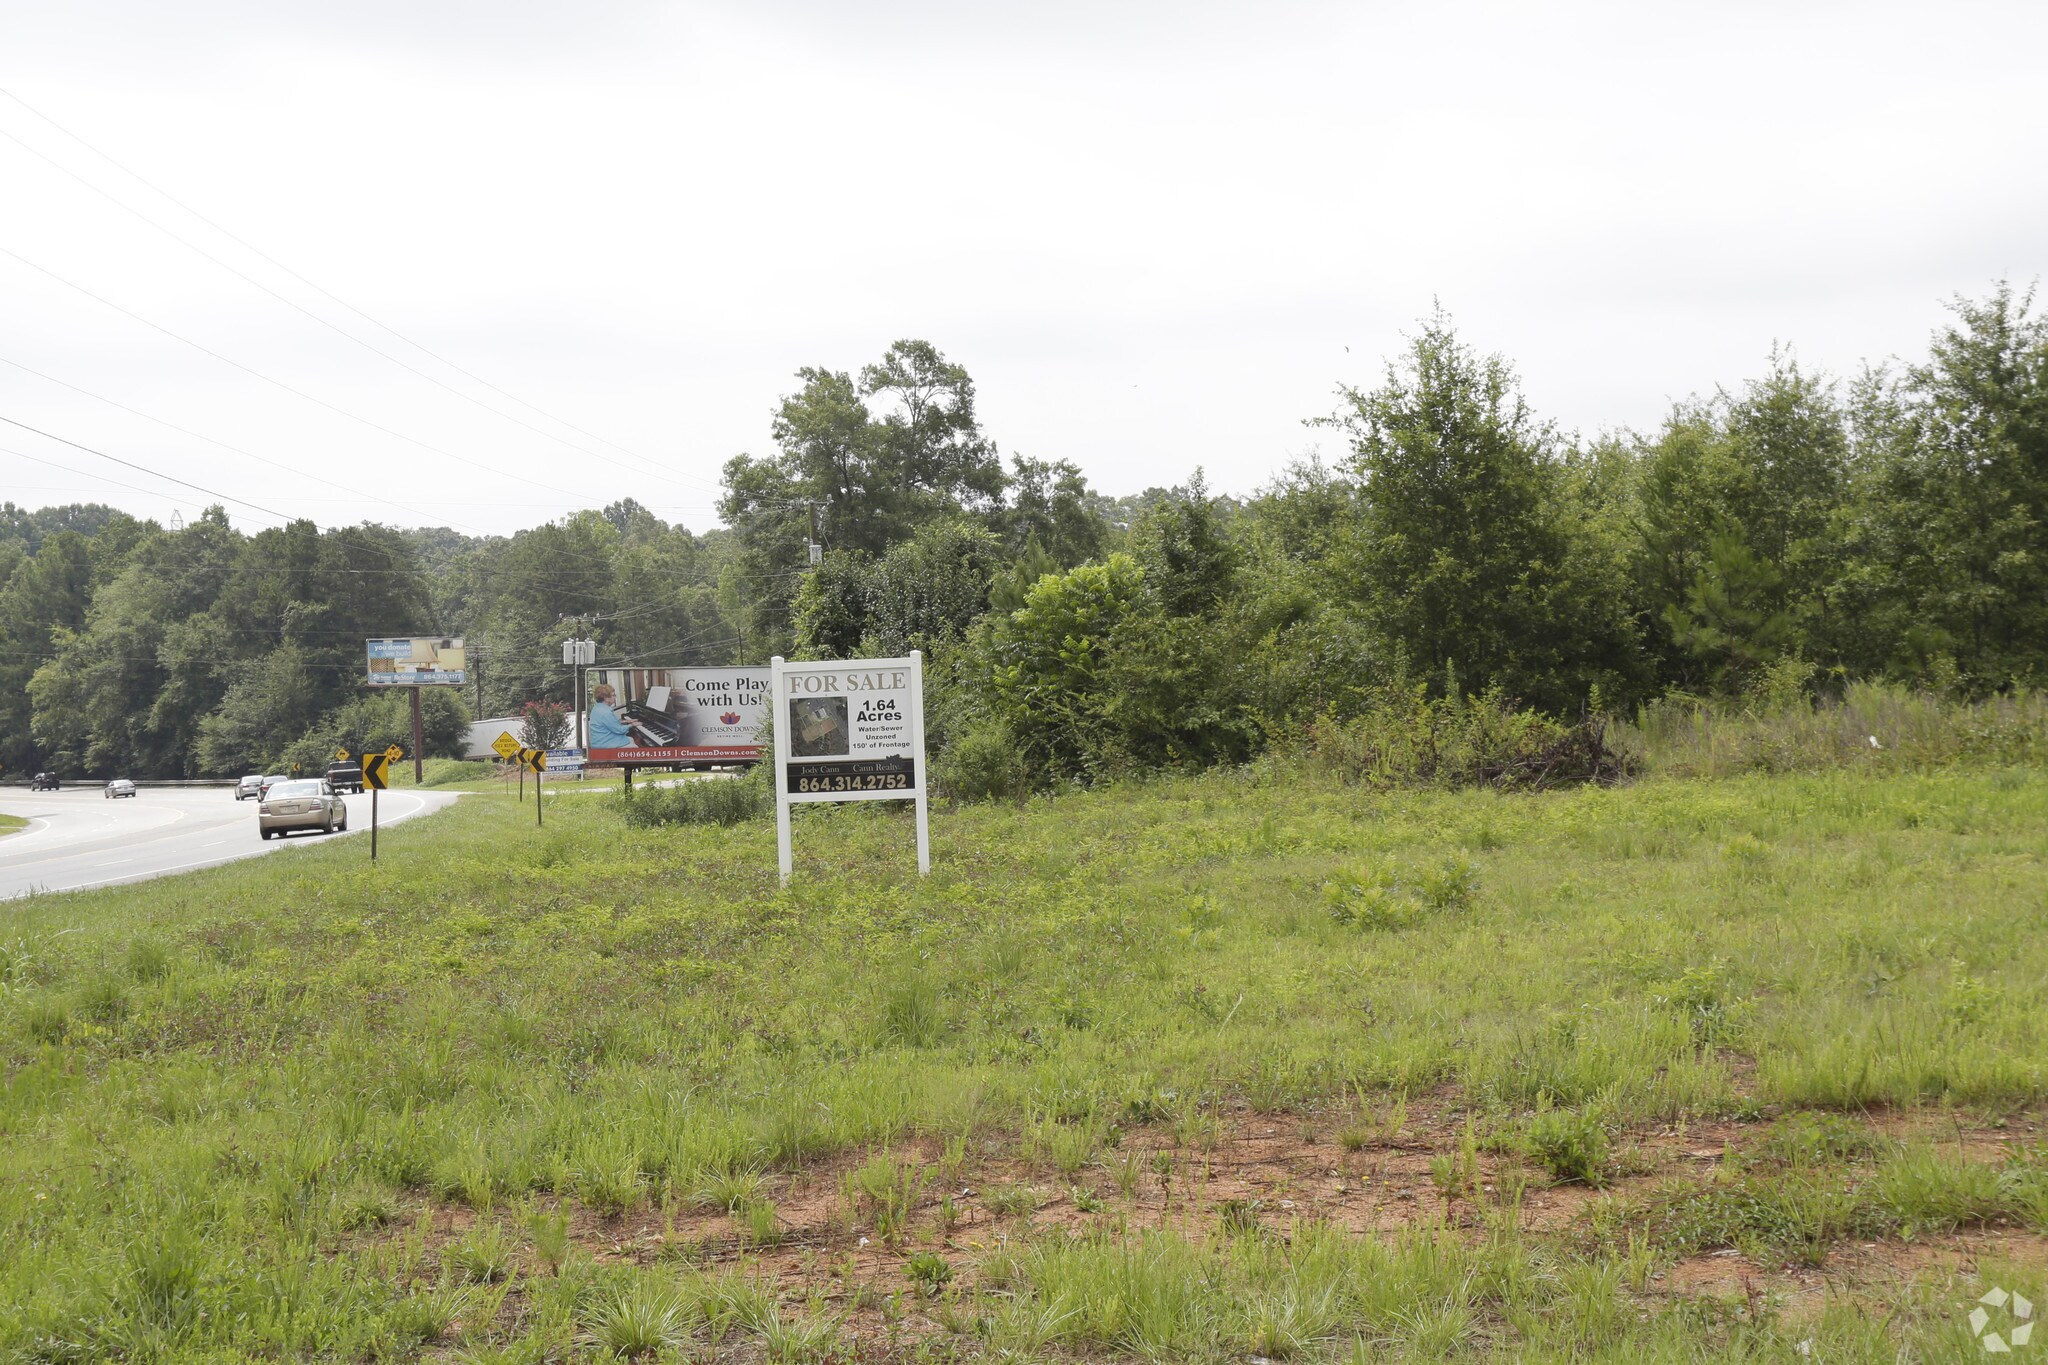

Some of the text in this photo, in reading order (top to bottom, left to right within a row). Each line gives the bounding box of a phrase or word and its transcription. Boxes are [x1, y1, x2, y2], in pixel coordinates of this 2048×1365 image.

[374, 643, 411, 652] you donate
[685, 677, 769, 693] Come Play
[790, 672, 906, 693] FOR SALE
[697, 693, 762, 707] with Us!
[862, 699, 896, 712] 1.64
[856, 711, 902, 722] Acres
[617, 750, 671, 758] (864)654.1155
[680, 749, 758, 757] ClemsonDowns.com
[801, 765, 840, 775] Jody Cann
[852, 763, 899, 772] Cann Realty
[799, 774, 907, 792] 864.314.2752
